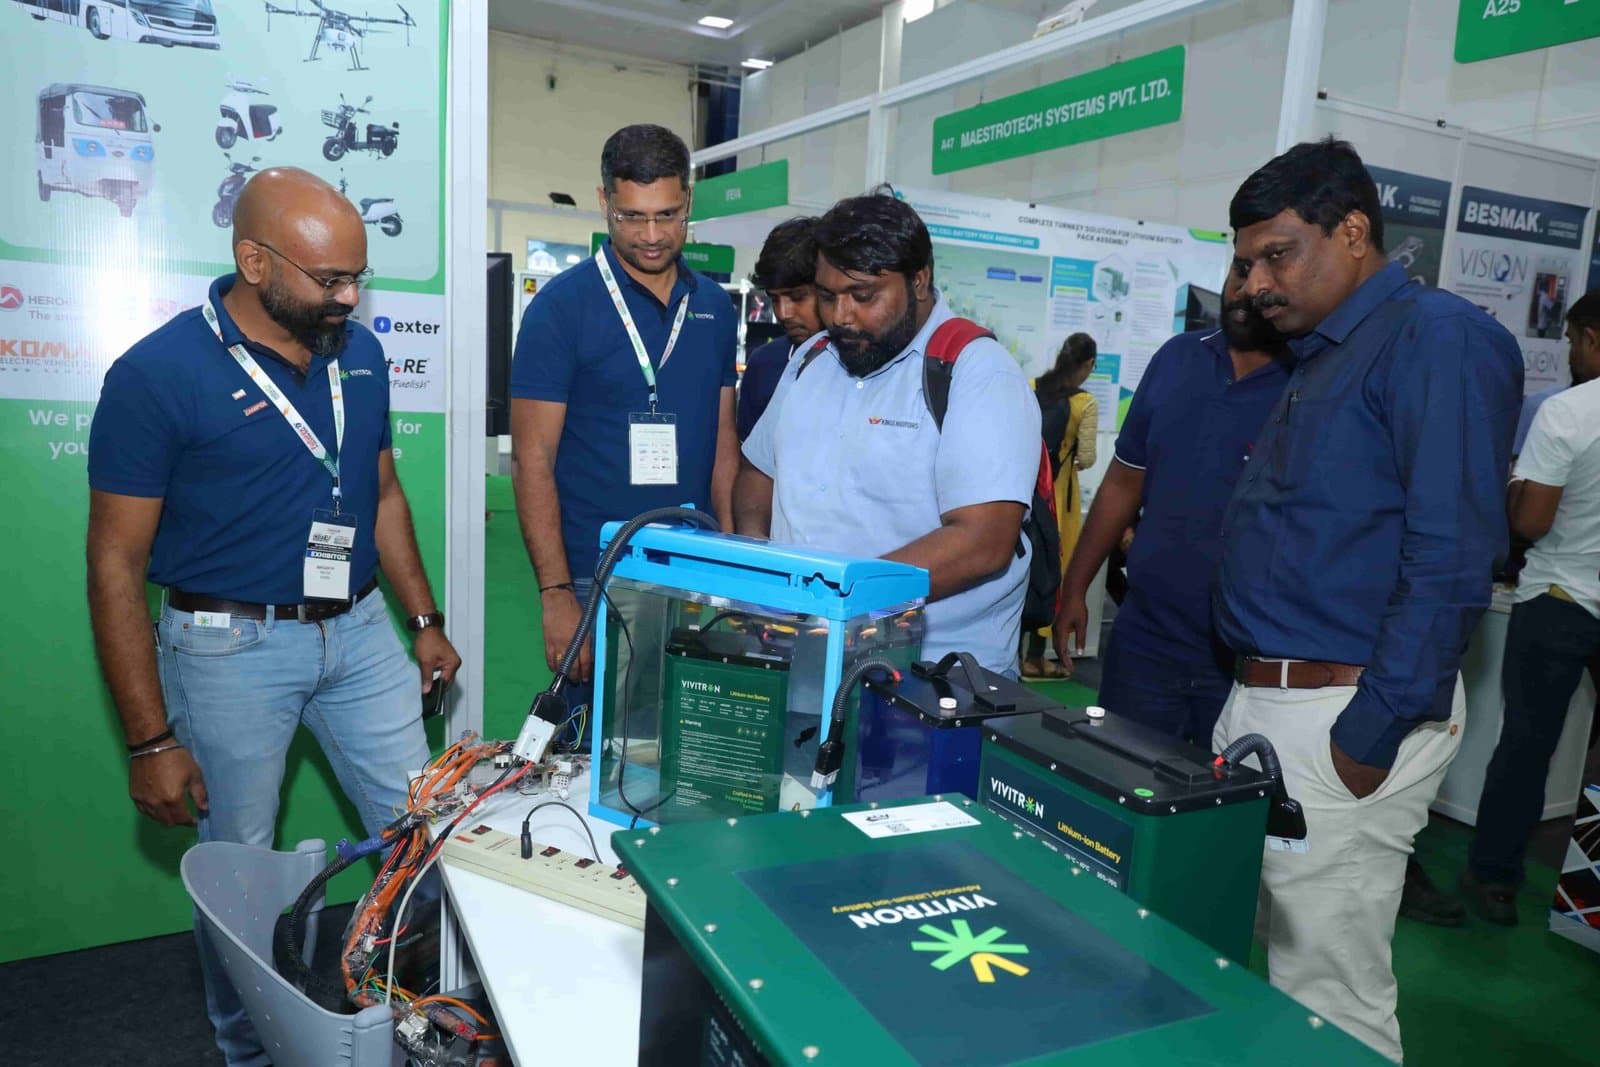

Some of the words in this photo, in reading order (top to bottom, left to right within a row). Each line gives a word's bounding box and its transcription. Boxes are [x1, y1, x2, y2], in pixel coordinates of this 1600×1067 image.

[941, 137, 955, 150] A47
[960, 112, 1043, 148] MAESTROTECH
[1045, 94, 1105, 127] SYSTEMS
[1108, 86, 1137, 111] PVT.
[1140, 78, 1172, 103] LTD.
[1017, 215, 1053, 228] COMPLETE
[1054, 220, 1084, 232] TURNKEY
[1085, 225, 1117, 236] SOLUTION
[1464, 200, 1544, 233] BESMAK.
[1076, 233, 1094, 242] PACK
[1096, 236, 1129, 246] ASSEMBLY
[394, 320, 441, 335] exter
[28, 408, 69, 427] We
[396, 418, 422, 435] for
[1057, 820, 1095, 849] Lithium-ion
[1094, 841, 1121, 864] Battery
[848, 893, 998, 930] VIVITRON
